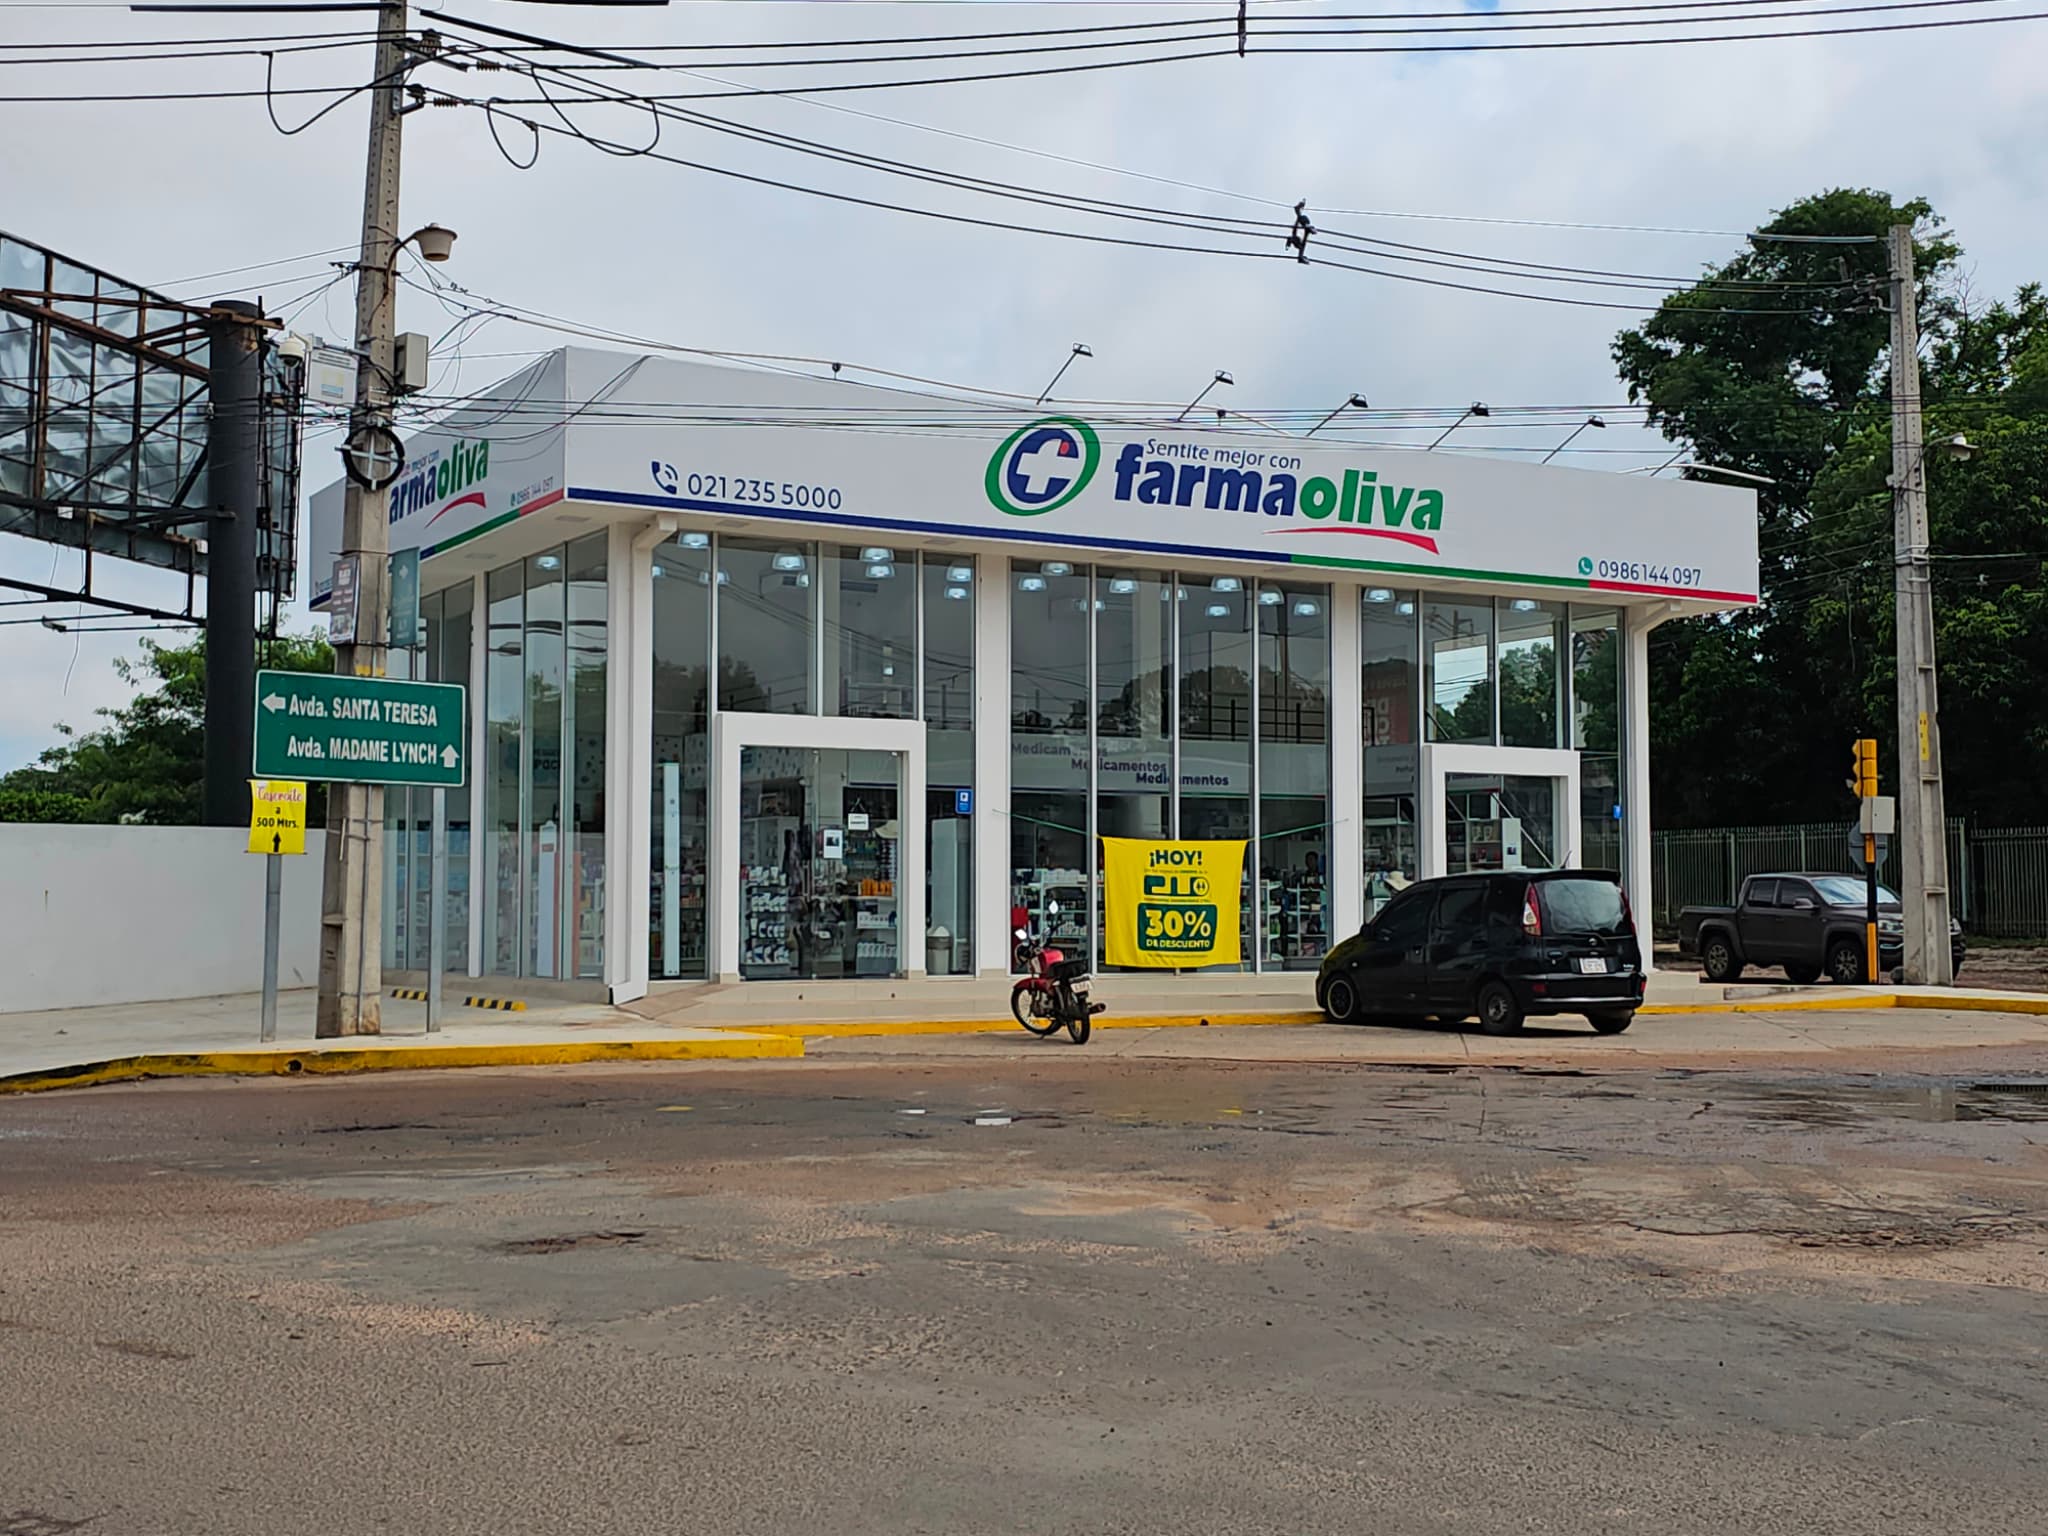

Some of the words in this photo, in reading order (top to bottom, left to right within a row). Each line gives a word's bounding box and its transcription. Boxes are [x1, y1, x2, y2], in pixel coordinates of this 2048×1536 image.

[1147, 439, 1209, 461] Sentite
[1214, 445, 1265, 469] mejor
[1269, 453, 1301, 470] con
[388, 438, 489, 526] armaoliva
[688, 473, 726, 498] 021
[734, 478, 775, 503] 235
[781, 484, 842, 509] 5000
[1114, 443, 1444, 531] farmaoliva
[1672, 567, 1702, 586] 097
[289, 694, 328, 718] Avda.
[333, 697, 380, 721] SANTA
[383, 701, 438, 727] TERESA
[287, 735, 325, 759] Avda.
[329, 737, 389, 762] MADAME
[392, 742, 437, 765] LYNCH
[1071, 757, 1166, 772] Meicamentos
[1136, 773, 1229, 786] Medimentos
[275, 806, 281, 815] a
[256, 817, 275, 828] 500
[1149, 850, 1203, 867] ¡HOY!
[1145, 910, 1211, 937] 30%
[1159, 939, 1211, 949] DESCUENTO
